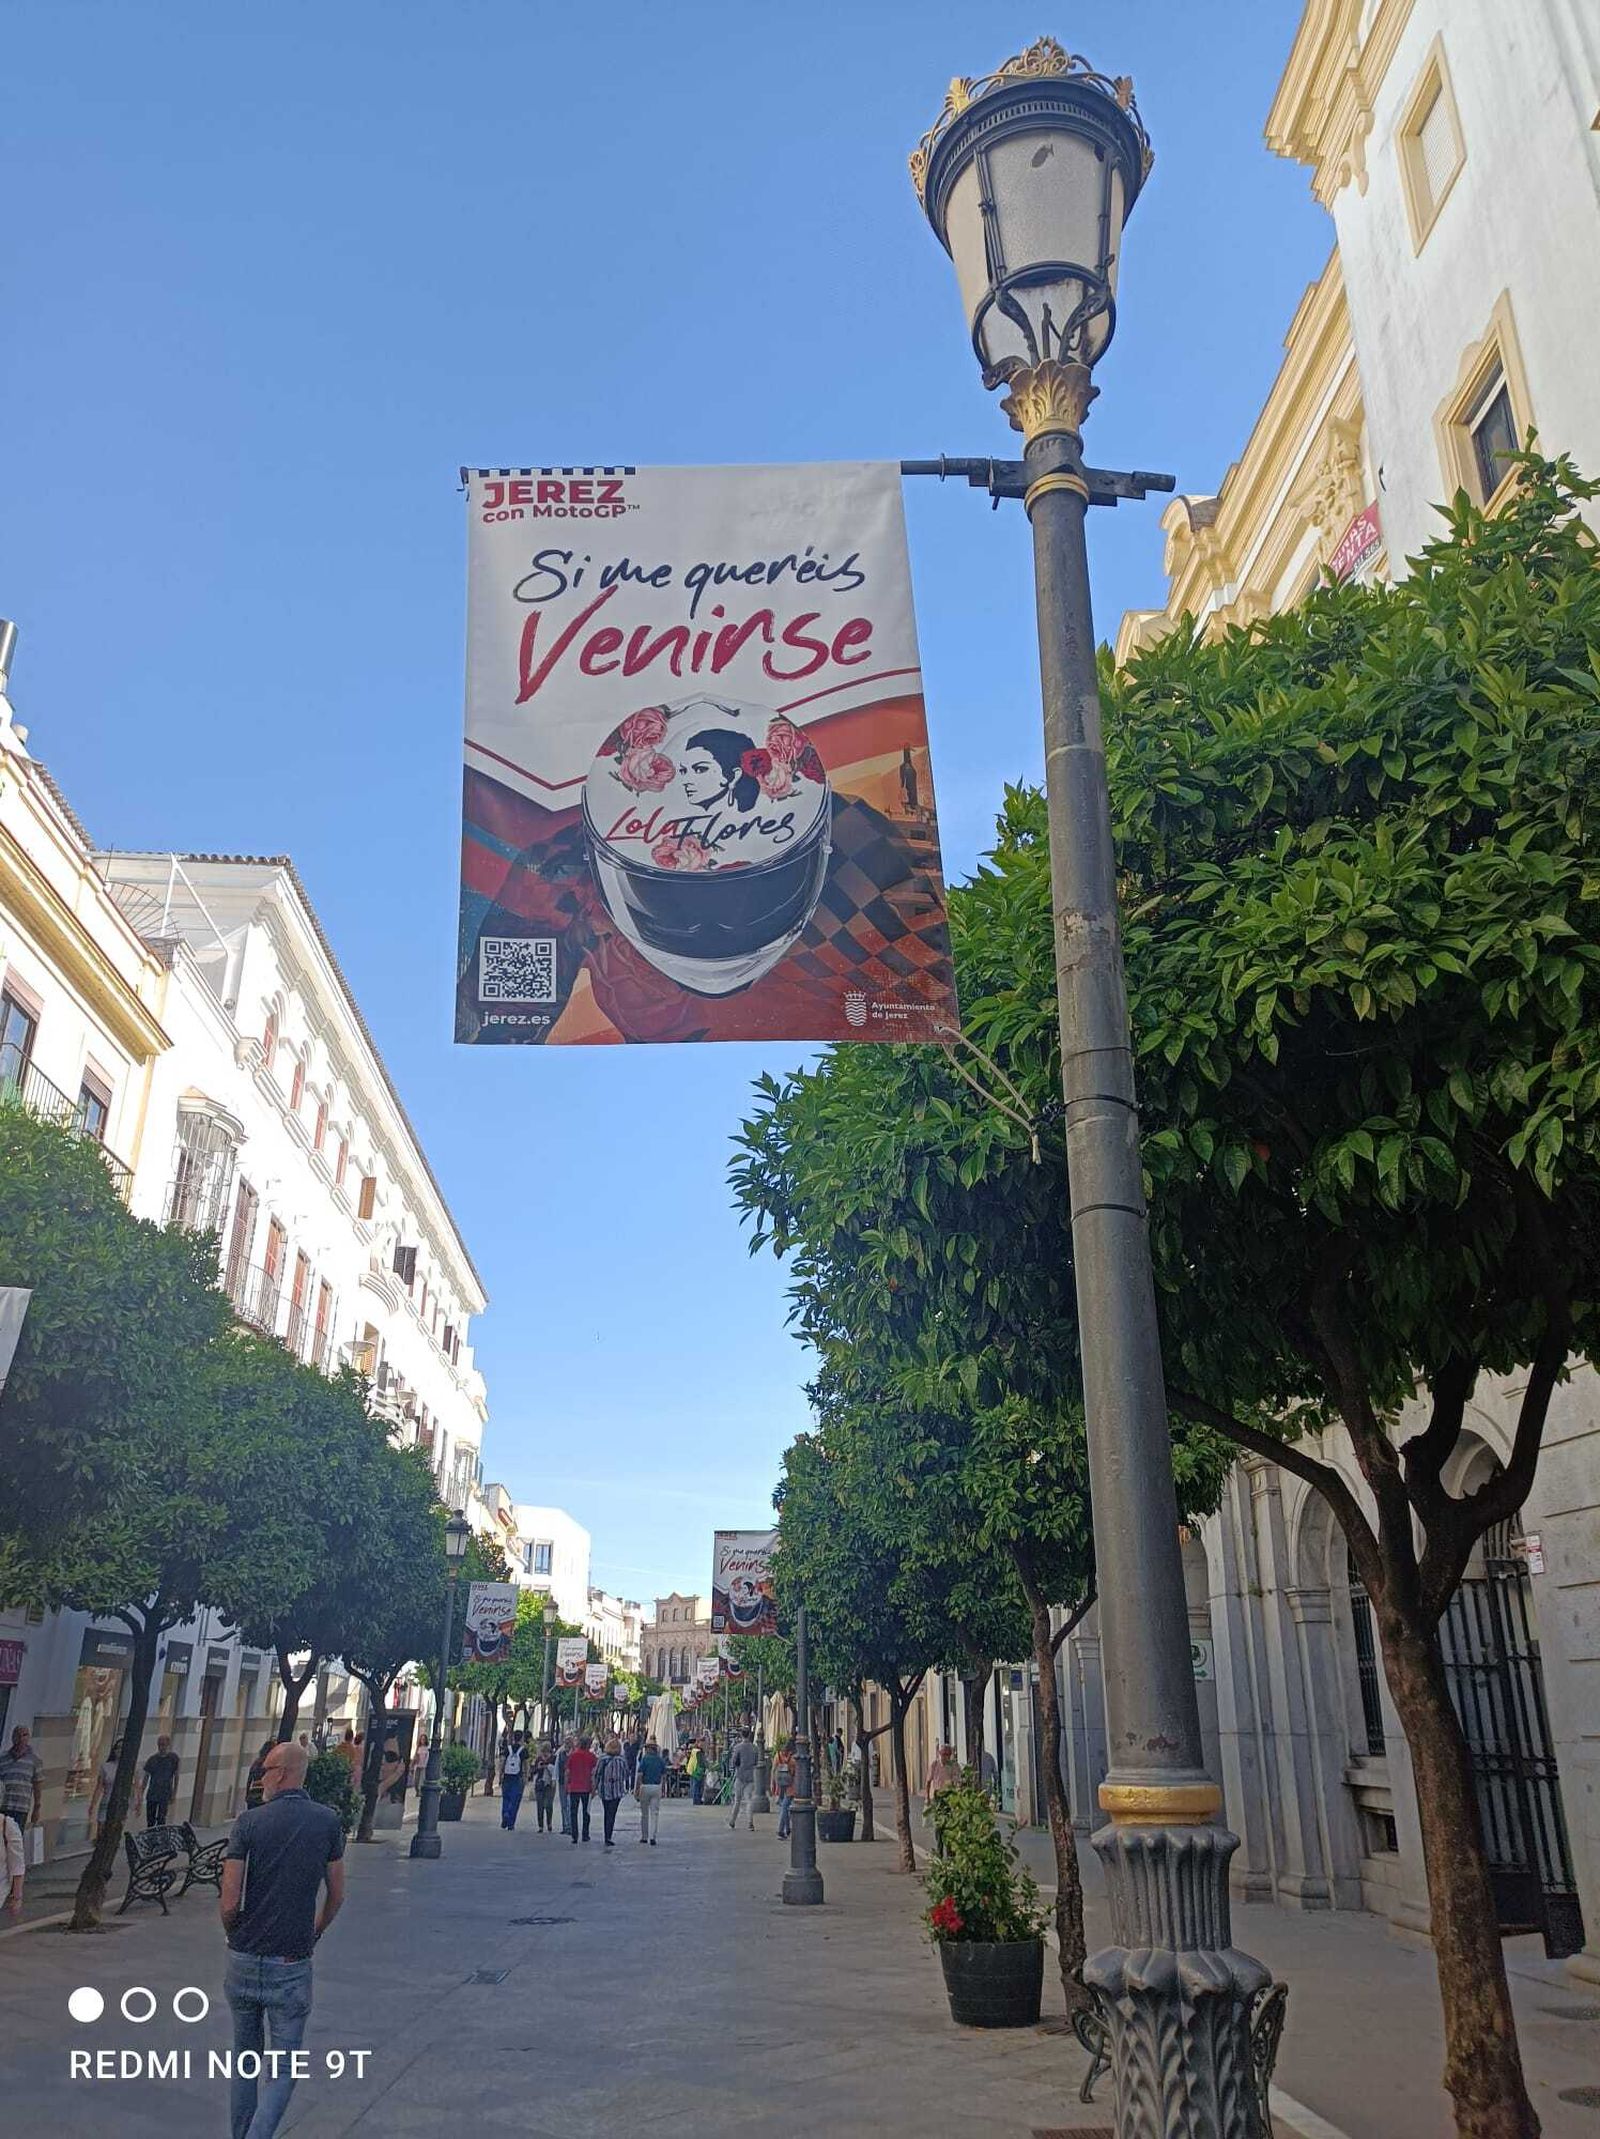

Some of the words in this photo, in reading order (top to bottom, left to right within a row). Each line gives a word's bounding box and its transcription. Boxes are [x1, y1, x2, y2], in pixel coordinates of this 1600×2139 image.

[481, 480, 625, 509] JEREZ
[482, 508, 524, 523] con
[513, 549, 592, 603] Si
[599, 557, 673, 588] me
[684, 546, 866, 619] queréis
[514, 584, 874, 704] Venirse
[604, 806, 682, 844] Lola
[670, 811, 796, 851] Flores
[481, 1011, 551, 1027] jerez.es
[871, 1002, 936, 1011] Ayuntamiento
